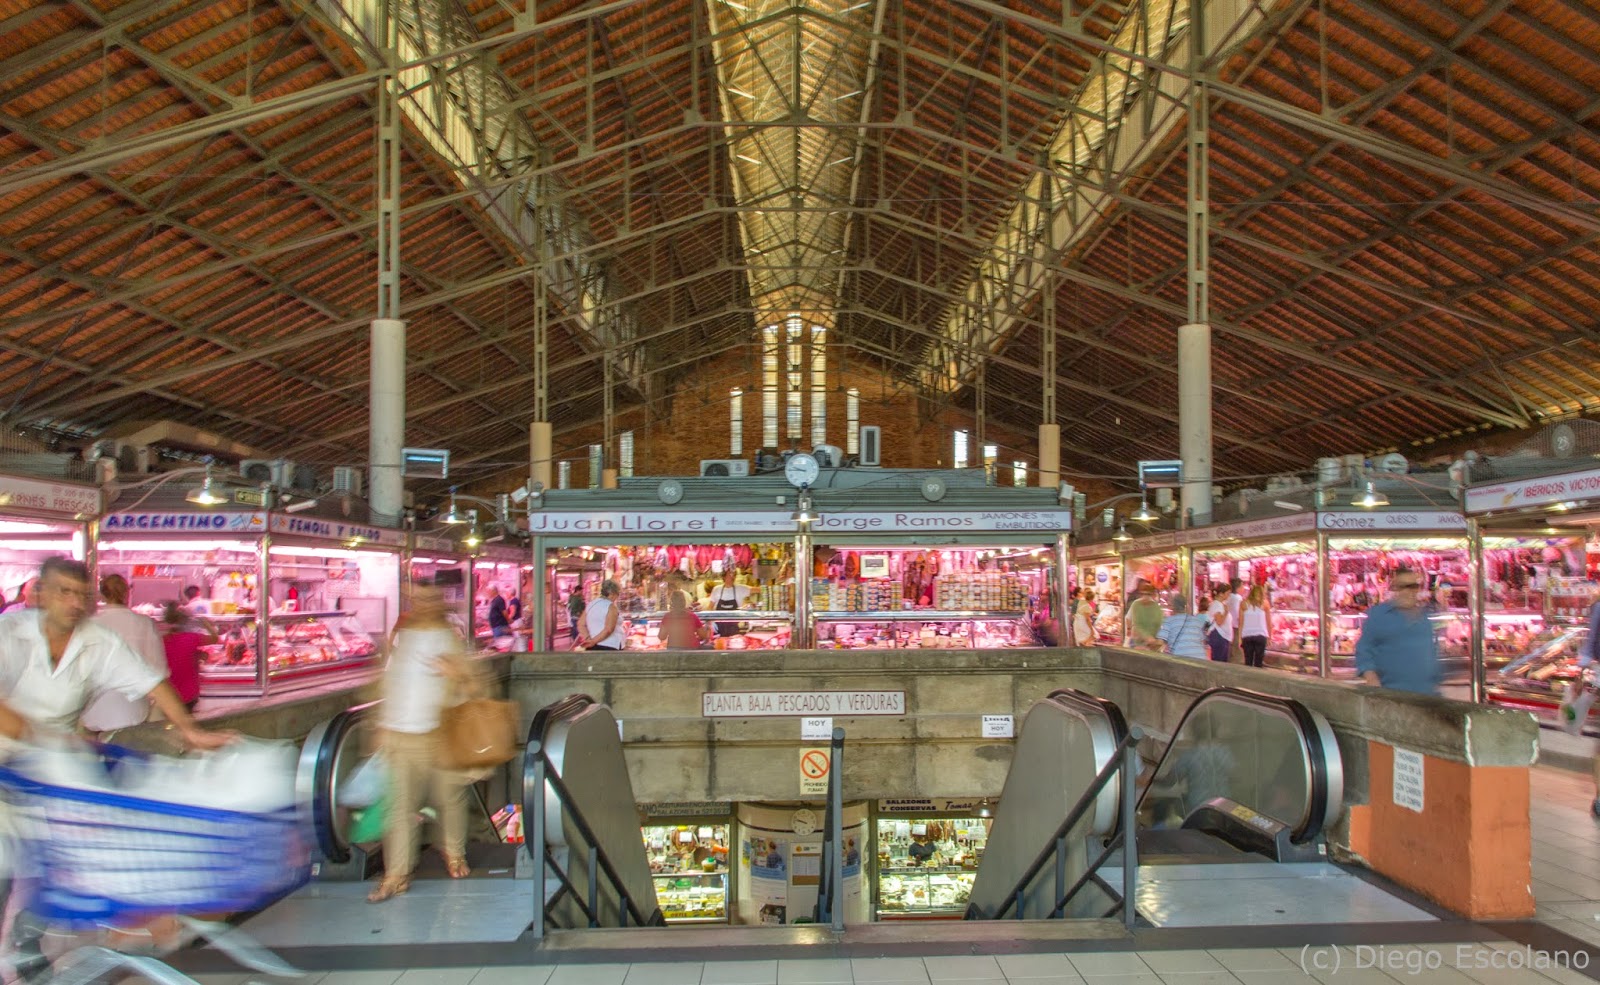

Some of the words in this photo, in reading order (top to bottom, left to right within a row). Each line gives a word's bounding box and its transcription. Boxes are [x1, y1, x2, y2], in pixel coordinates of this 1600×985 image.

[663, 486, 677, 497] 98
[927, 482, 940, 493] 99
[1523, 480, 1566, 498] IBÉRICOS
[1, 490, 46, 508] ARNES
[53, 498, 96, 513] FRESCAS
[106, 514, 227, 529] ARGENTINO
[535, 514, 613, 531] Juan
[620, 514, 720, 531] Lloret
[815, 513, 883, 530] Jorge
[894, 513, 974, 527] Ramos
[979, 511, 1038, 520] JAMONES
[1322, 511, 1376, 528] Gómez
[1385, 514, 1418, 525] QUESOS
[337, 526, 344, 536] Y
[994, 520, 1062, 529] EMBUTIDOS
[705, 695, 743, 712] PLANTA
[749, 695, 772, 711] BAJA
[778, 694, 831, 712] PESCADOS
[836, 695, 843, 711] Y
[849, 693, 899, 711] VERDURAS
